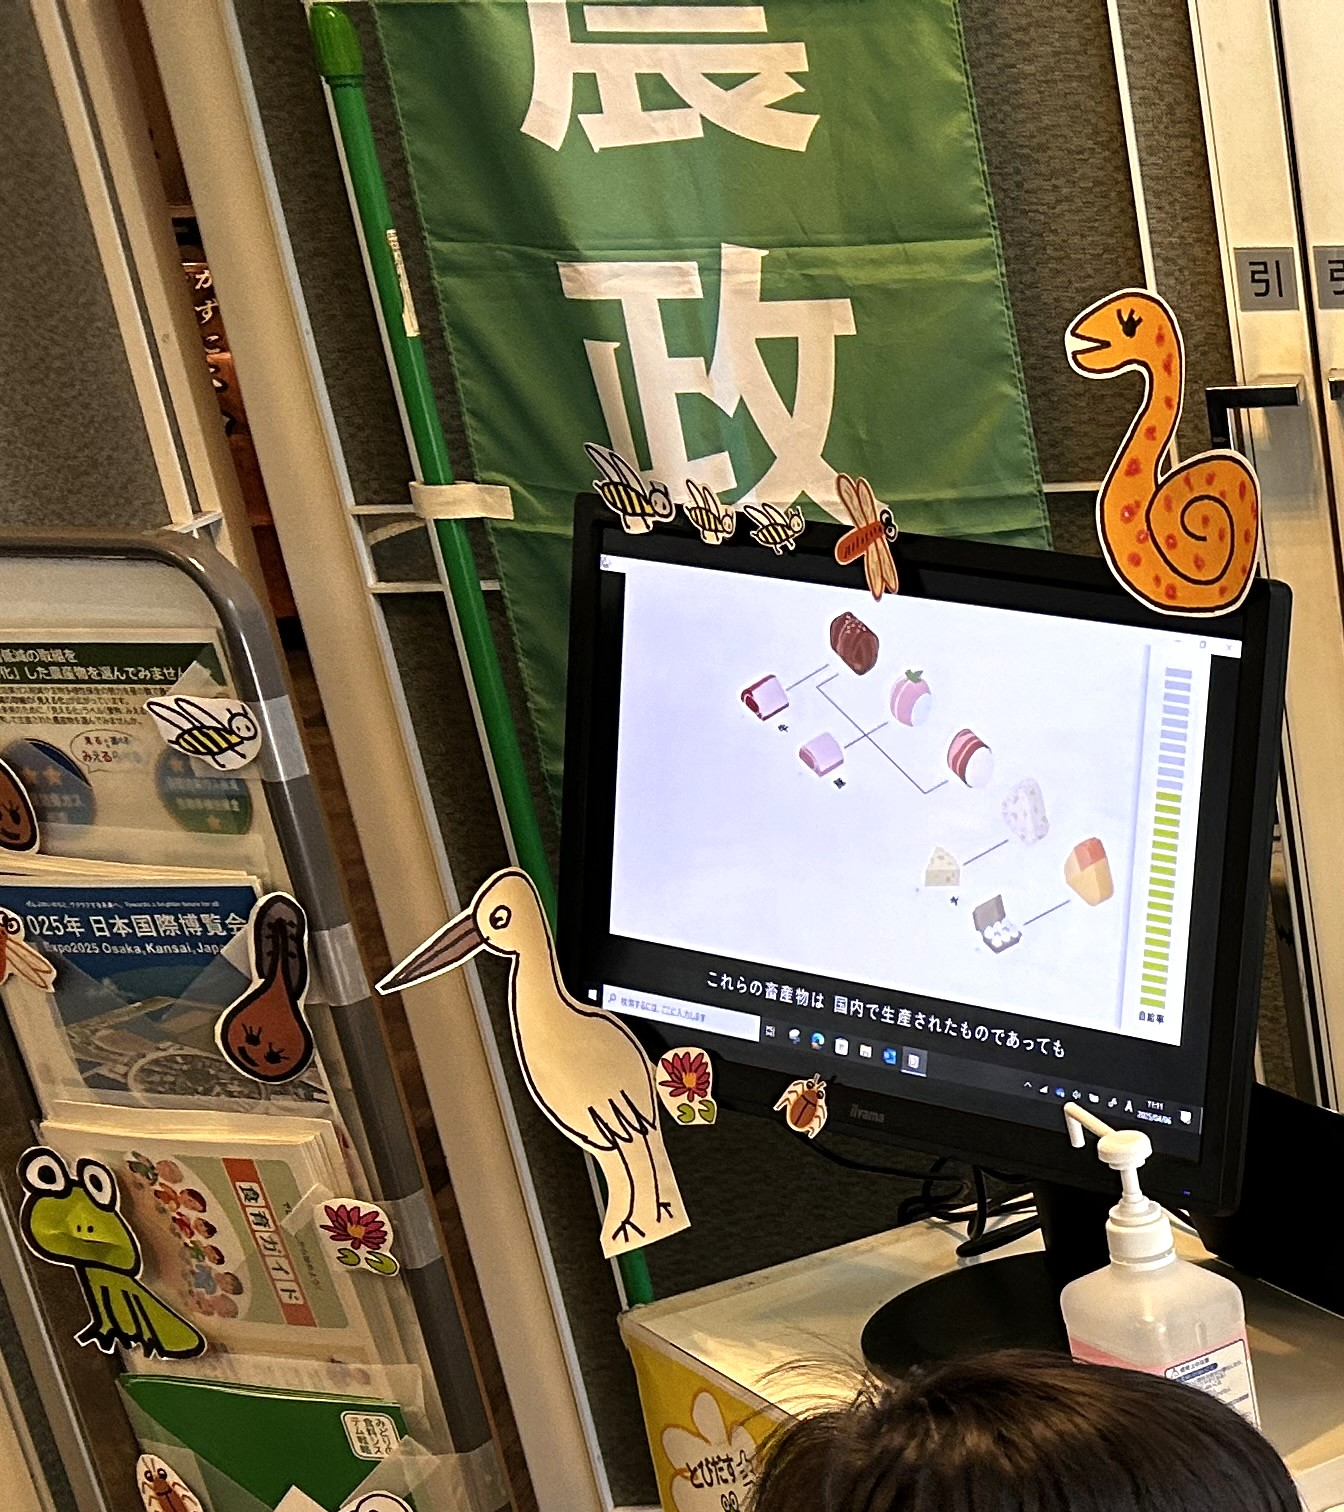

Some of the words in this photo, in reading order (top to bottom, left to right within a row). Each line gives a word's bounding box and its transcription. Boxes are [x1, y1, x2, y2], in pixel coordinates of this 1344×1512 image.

[1249, 260, 1283, 297] 引
[25, 914, 85, 938] 025年
[707, 971, 824, 1009] これらの畜産物は
[834, 995, 1065, 1058] 国内で生産されたものであっても
[238, 1183, 300, 1301] 食育ガイド
[687, 1452, 738, 1489] とびだす
